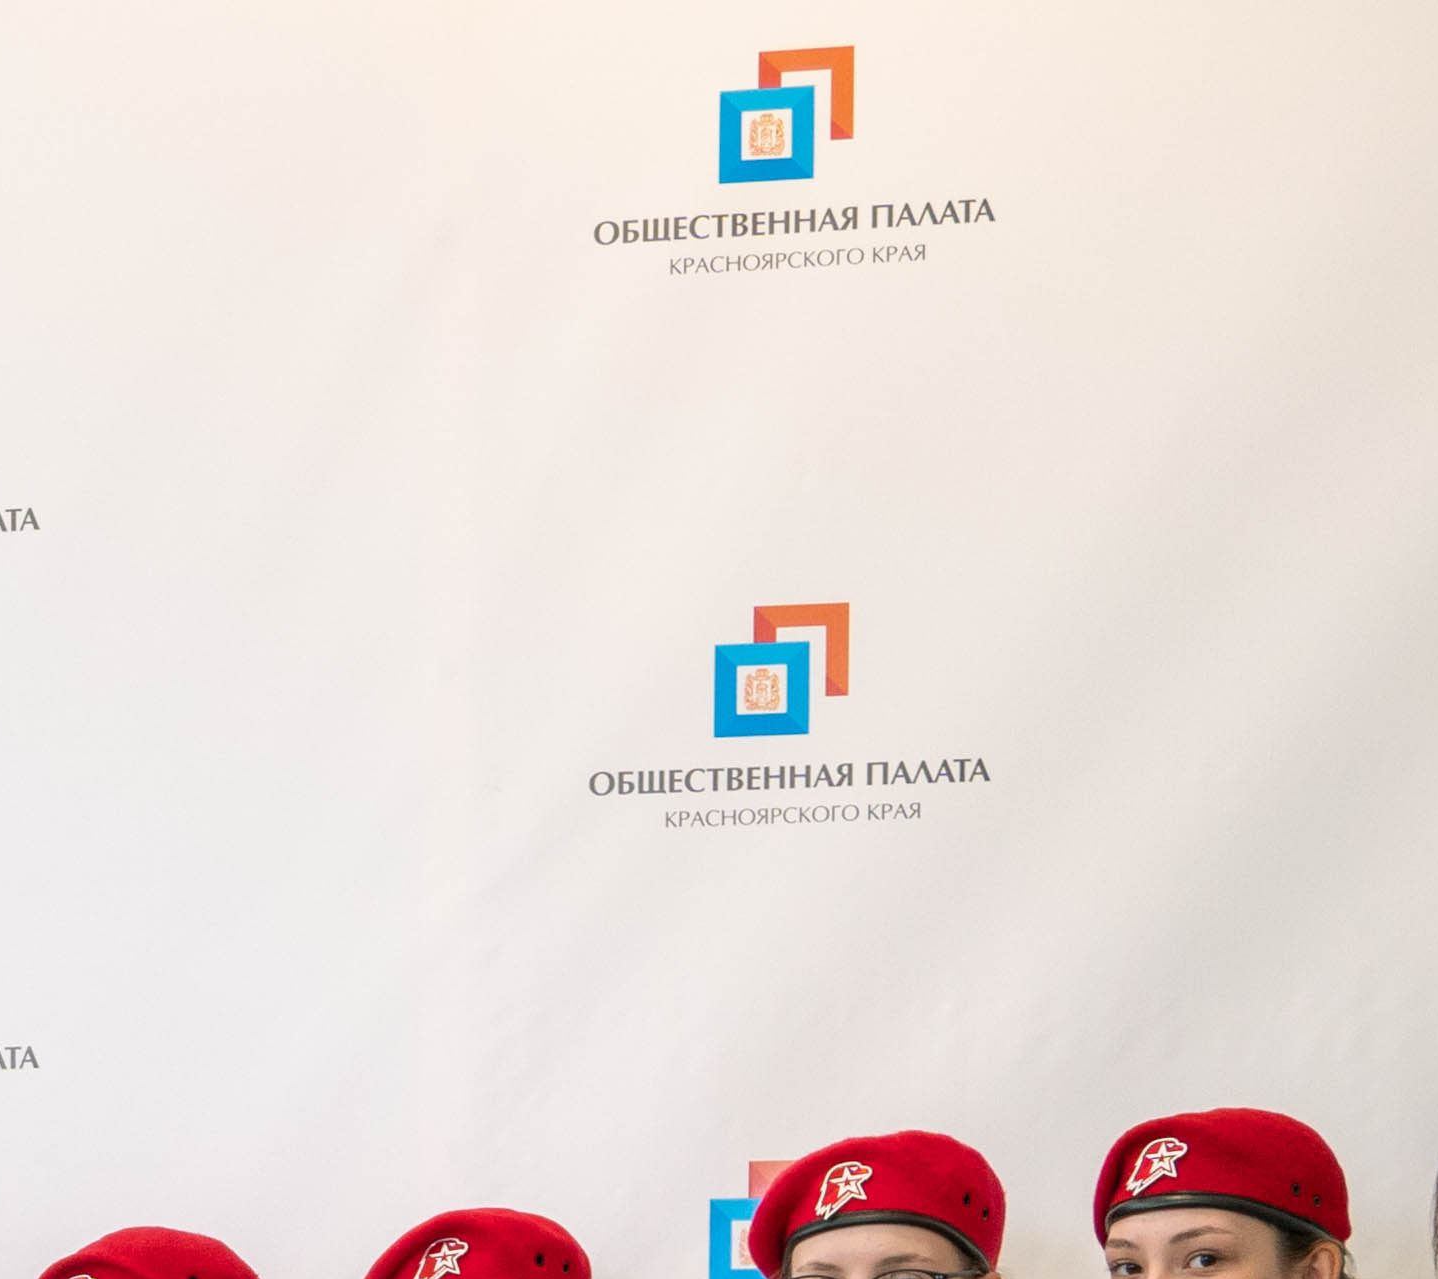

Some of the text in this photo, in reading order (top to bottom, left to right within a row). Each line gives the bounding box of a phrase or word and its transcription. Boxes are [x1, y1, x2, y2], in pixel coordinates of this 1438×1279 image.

[593, 198, 996, 245] ОБЩЕСТВЕННАЯ ПАЛАТА
[670, 244, 927, 275] КРАСНОЯРСКОГО КРАЯ
[589, 758, 992, 796] ОБЩЕСТВЕННАЯ ПАЛАТА
[665, 802, 922, 828] КРАСНОЯРСКОГО КРАЯ
